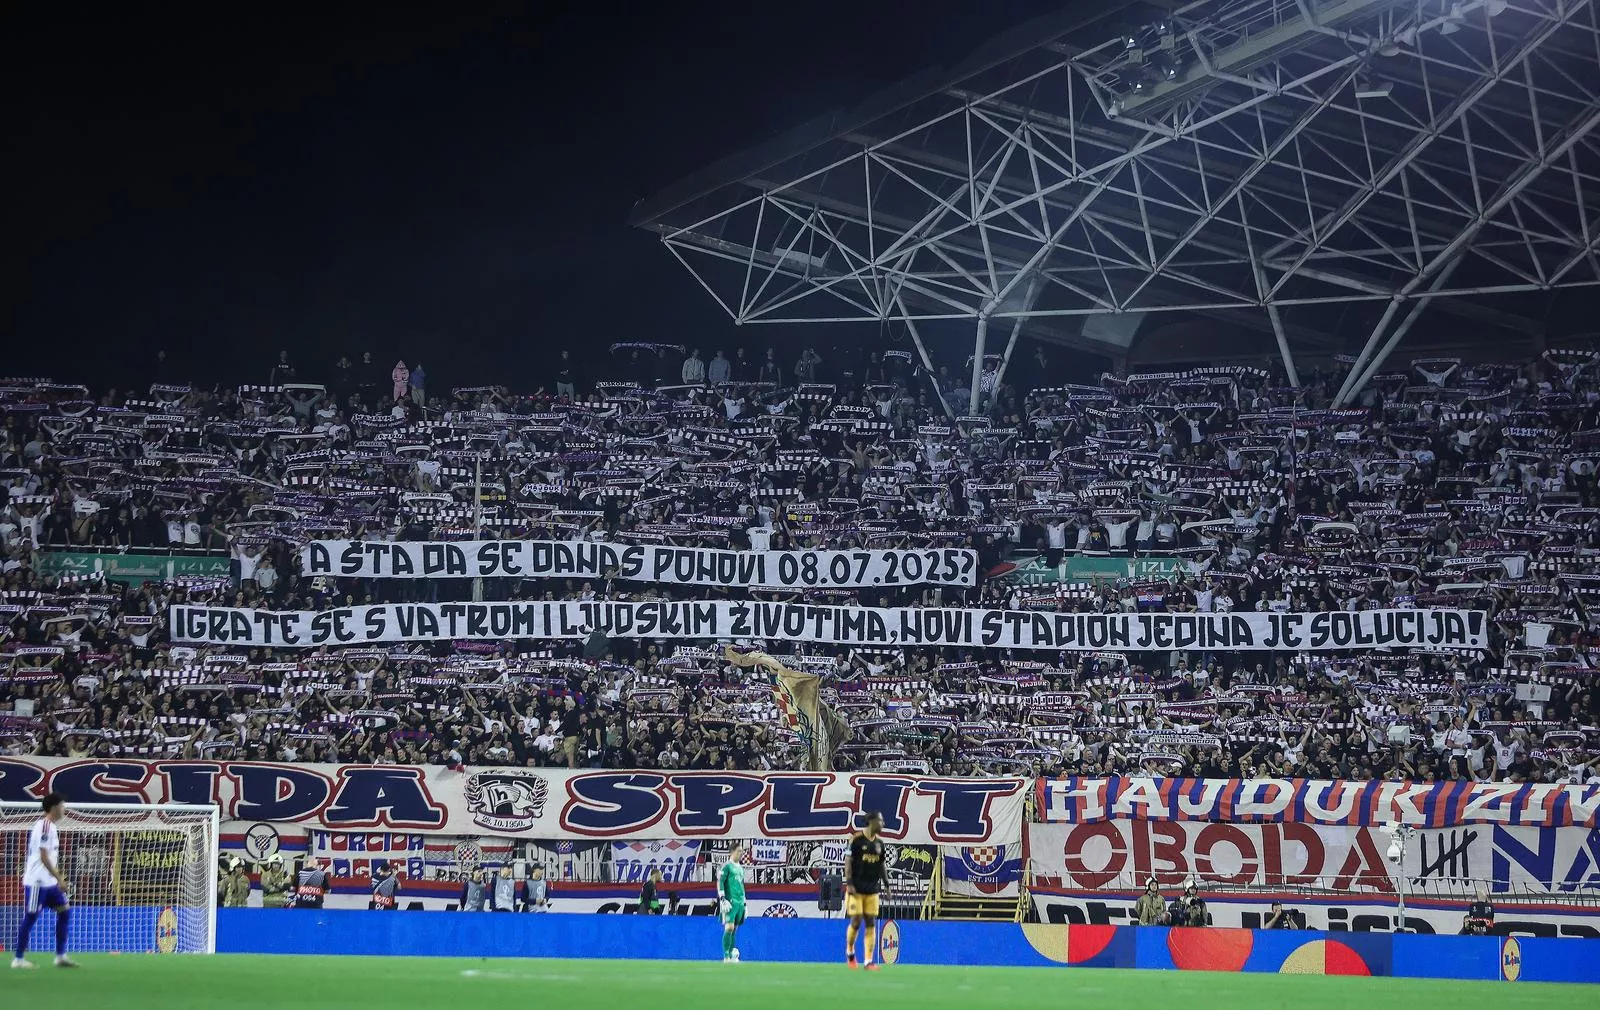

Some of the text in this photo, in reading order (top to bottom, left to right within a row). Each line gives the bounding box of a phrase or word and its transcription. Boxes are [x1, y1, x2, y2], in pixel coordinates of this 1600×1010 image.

[311, 541, 974, 585] A ŠTA DA SE DANAS PONOVI 08.07.2025?
[177, 608, 300, 644] IGRATE
[311, 608, 352, 643] SE
[365, 607, 386, 640] S
[396, 604, 534, 637] VATROM
[544, 604, 551, 636] I
[560, 602, 717, 637] LJUDSKIM
[981, 612, 1130, 648] STADION
[1137, 614, 1254, 648] JEDINA
[1263, 614, 1302, 647] JE
[1310, 610, 1484, 647] SOLUCIJA!
[560, 769, 1025, 843] SPLIT
[1046, 778, 1427, 825] HAJDUK
[765, 903, 797, 917] HAJDUK
